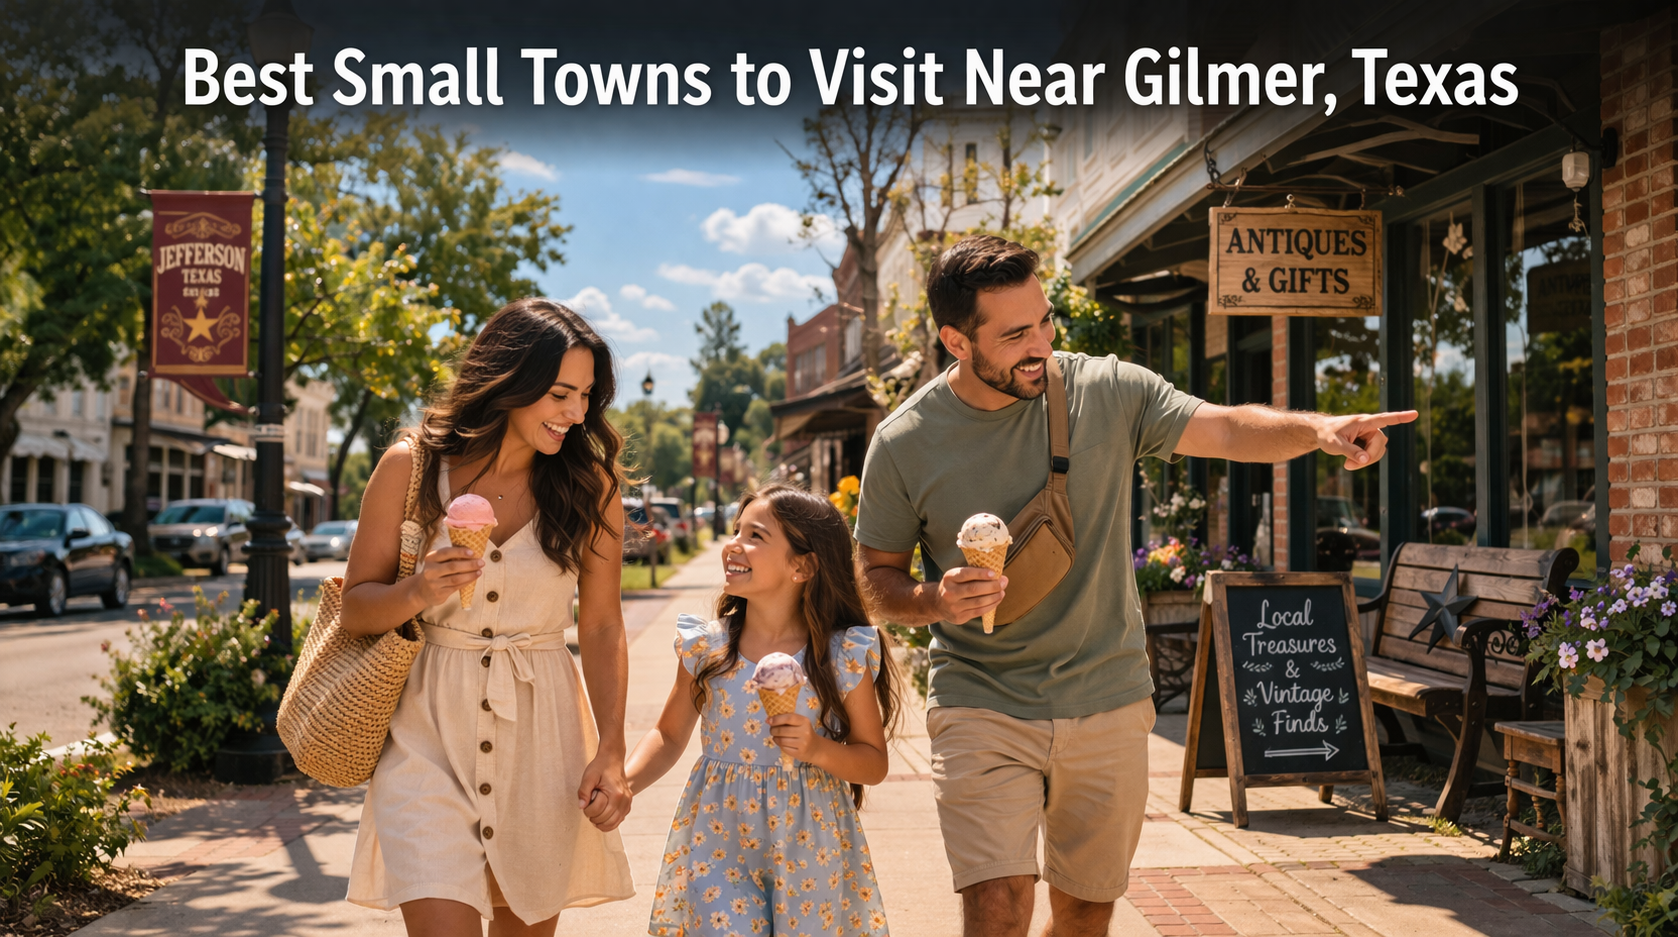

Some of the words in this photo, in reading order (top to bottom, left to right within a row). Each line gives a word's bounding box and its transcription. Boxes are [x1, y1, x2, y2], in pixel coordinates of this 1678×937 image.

[1226, 227, 1367, 260] ANTIQUES
[157, 243, 246, 274] JEFFERSON
[181, 268, 222, 284] TEXAS
[1242, 267, 1261, 293] &
[1269, 267, 1350, 294] GIFTS
[1257, 598, 1314, 629] Local
[1242, 631, 1337, 656] Treasures
[1285, 659, 1300, 678] &
[1257, 681, 1334, 712] Vintage
[1271, 709, 1329, 735] Finds
